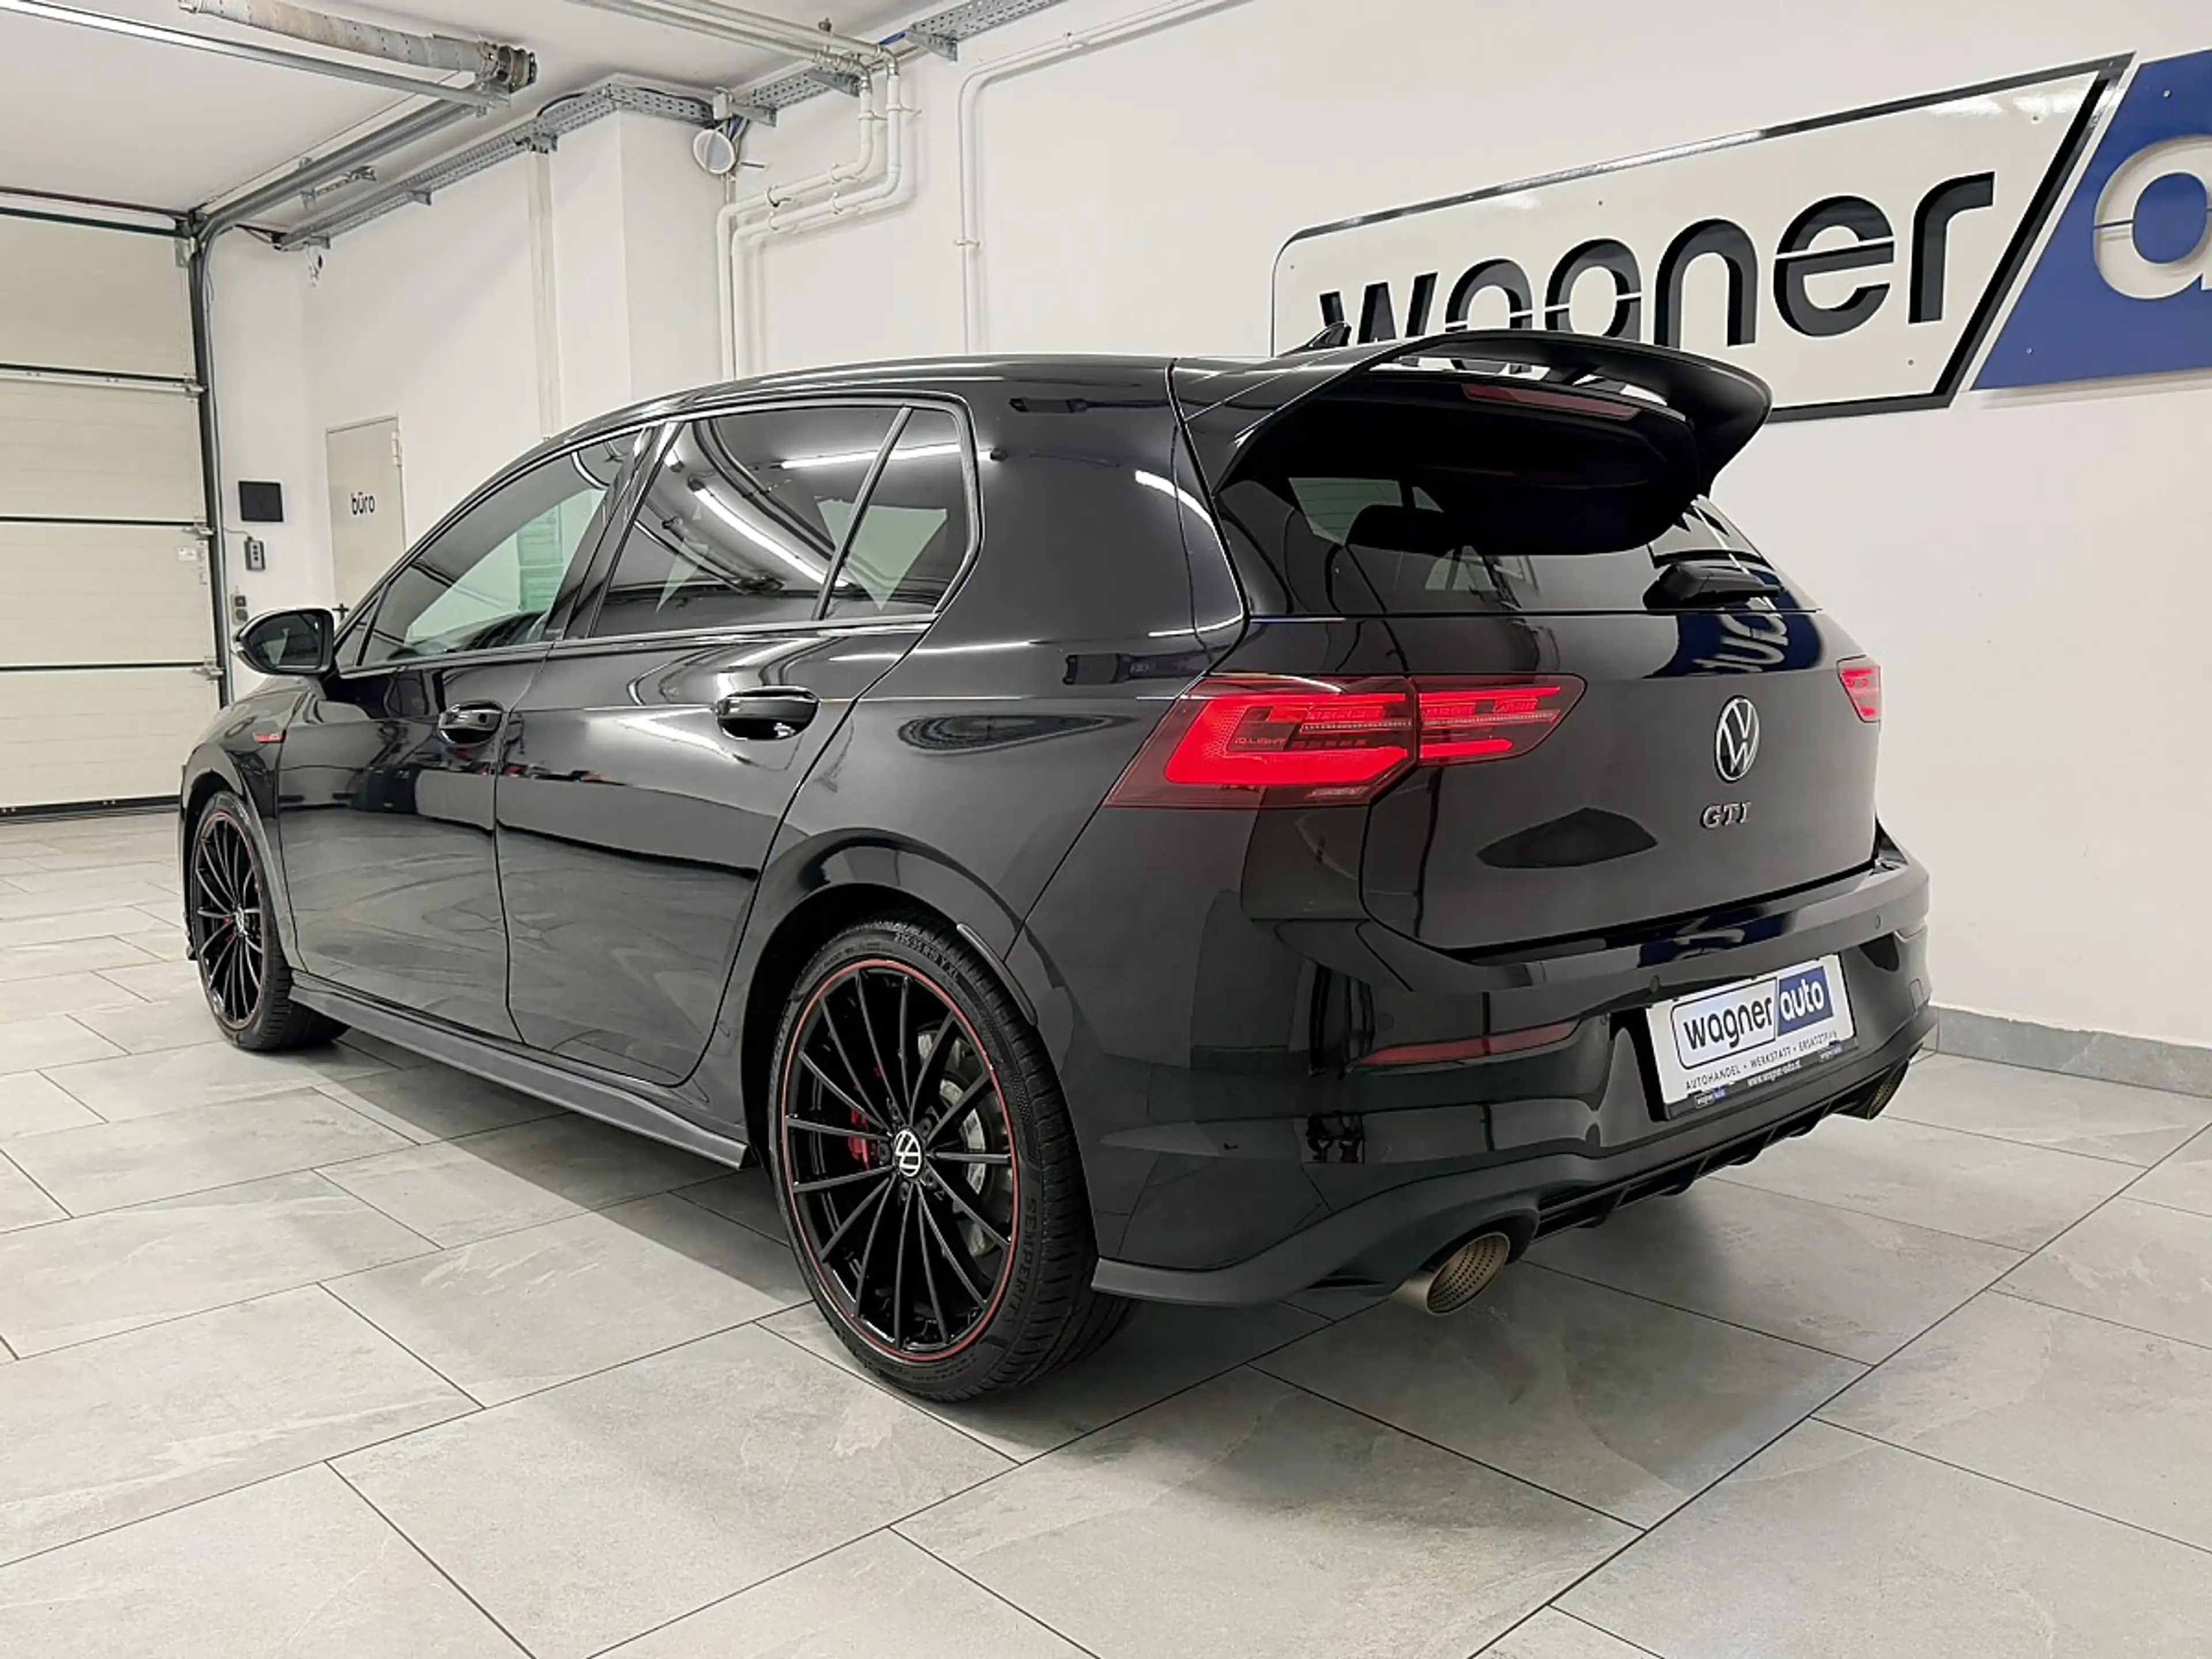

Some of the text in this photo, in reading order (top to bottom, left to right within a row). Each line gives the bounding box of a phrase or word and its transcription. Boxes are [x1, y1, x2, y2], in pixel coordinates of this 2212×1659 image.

[350, 491, 375, 515] büro
[1700, 800, 1752, 829] GTI
[1683, 979, 1824, 1049] wagner auto
[1686, 1065, 1741, 1090] AUTOHANDEL
